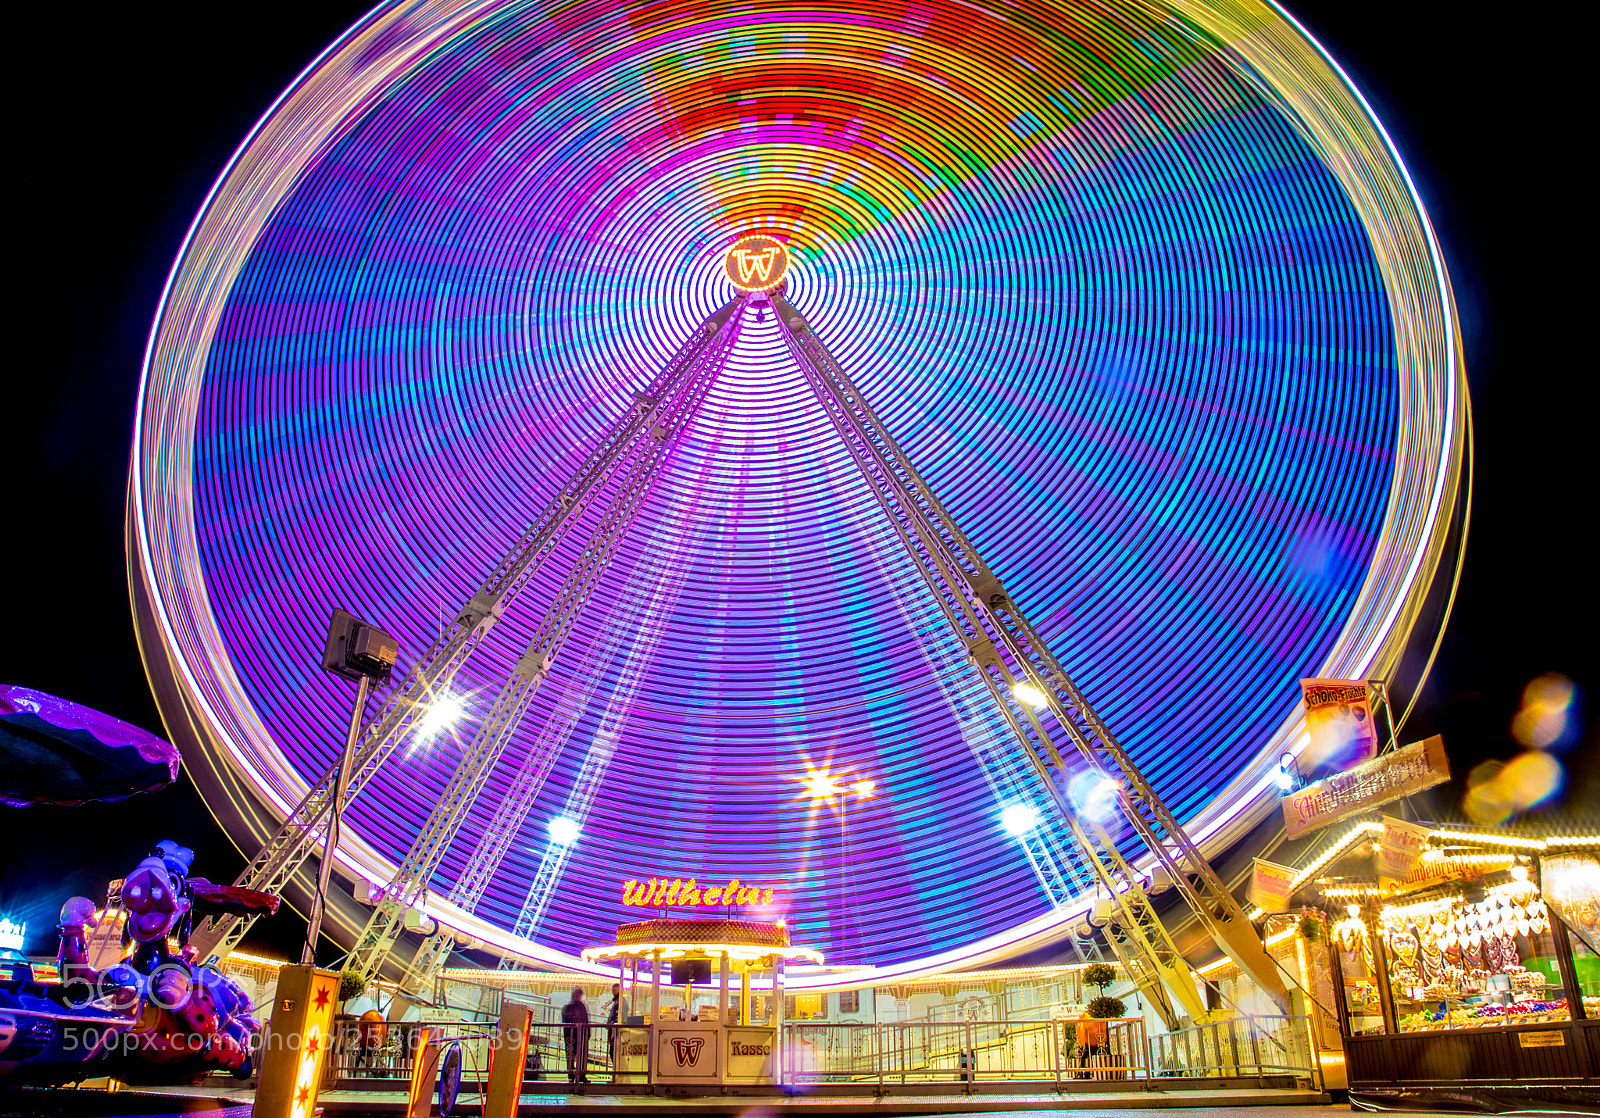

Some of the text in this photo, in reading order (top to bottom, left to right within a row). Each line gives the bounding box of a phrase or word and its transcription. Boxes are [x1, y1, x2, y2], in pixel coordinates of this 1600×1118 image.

[731, 247, 781, 284] W
[671, 1038, 705, 1067] W
[731, 1041, 771, 1056] Kasse
